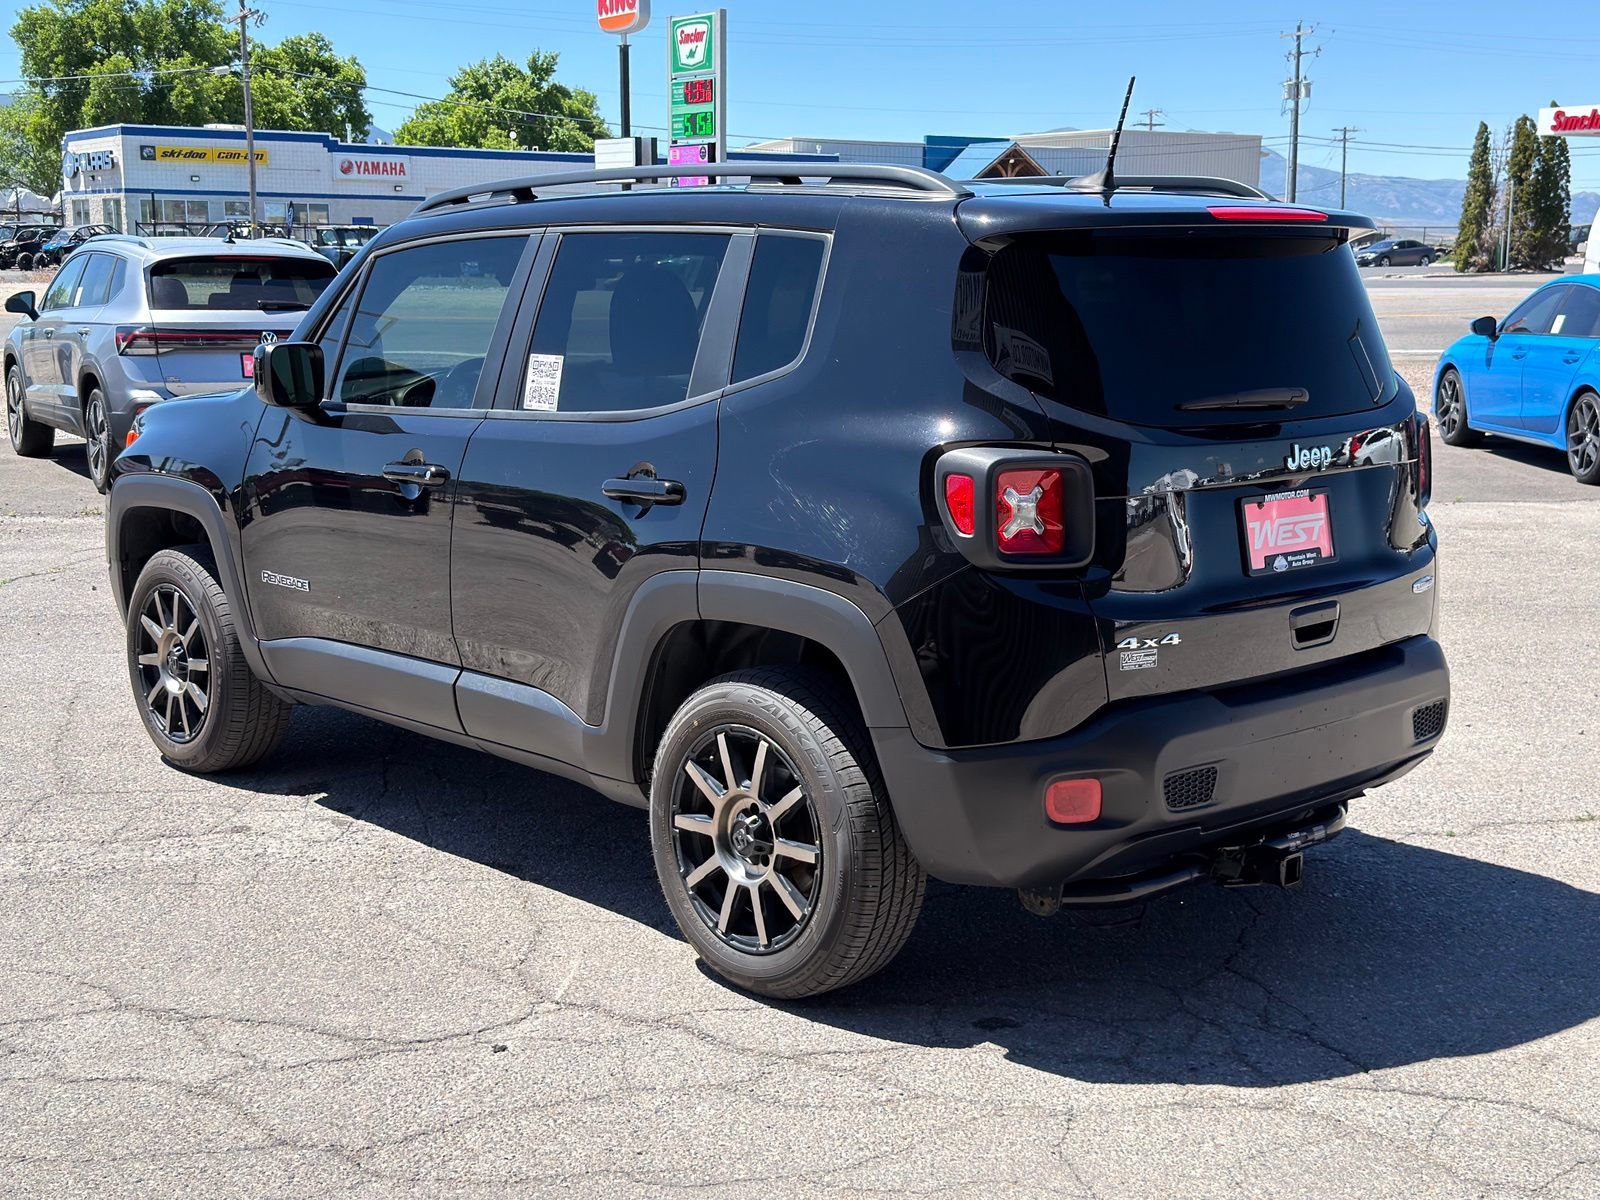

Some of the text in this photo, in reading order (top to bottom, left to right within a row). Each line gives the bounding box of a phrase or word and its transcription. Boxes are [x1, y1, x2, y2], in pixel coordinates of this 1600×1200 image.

[679, 28, 705, 44] Sinclair
[160, 149, 207, 160] ski-doo
[354, 160, 406, 176] YAMAHA
[1286, 443, 1332, 471] Jeep
[1264, 489, 1310, 502] MWMOTOR.COM
[1248, 512, 1325, 550] WEST
[261, 570, 310, 591] RENEGADE
[1117, 633, 1182, 649] 4x4
